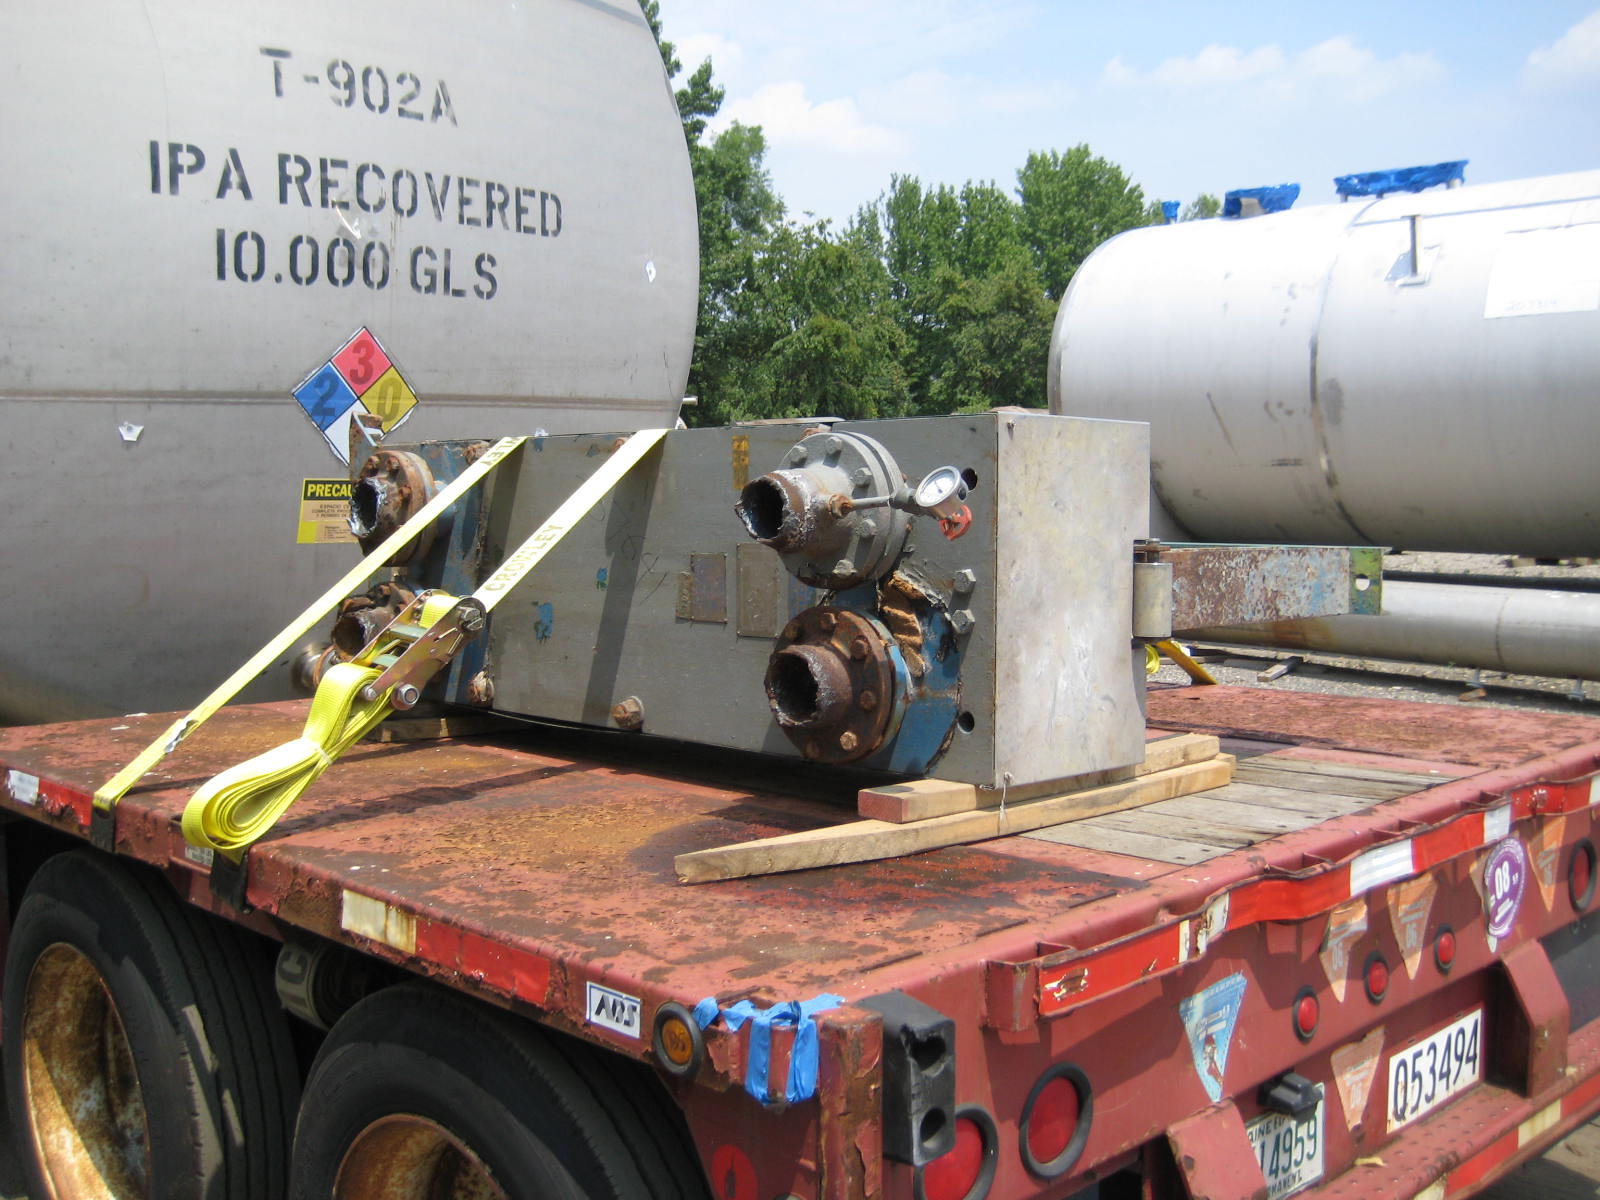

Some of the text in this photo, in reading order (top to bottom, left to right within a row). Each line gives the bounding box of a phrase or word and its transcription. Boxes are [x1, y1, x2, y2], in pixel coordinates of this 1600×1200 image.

[259, 46, 458, 127] T-902A
[149, 140, 562, 238] IPA RECOVERED
[410, 246, 498, 300] GLS
[349, 339, 374, 385] 3
[311, 372, 340, 417] 2
[376, 376, 403, 423] 0
[484, 524, 565, 592] CROWLEY
[594, 993, 638, 1028] ABS
[1393, 1017, 1479, 1122] Q53494
